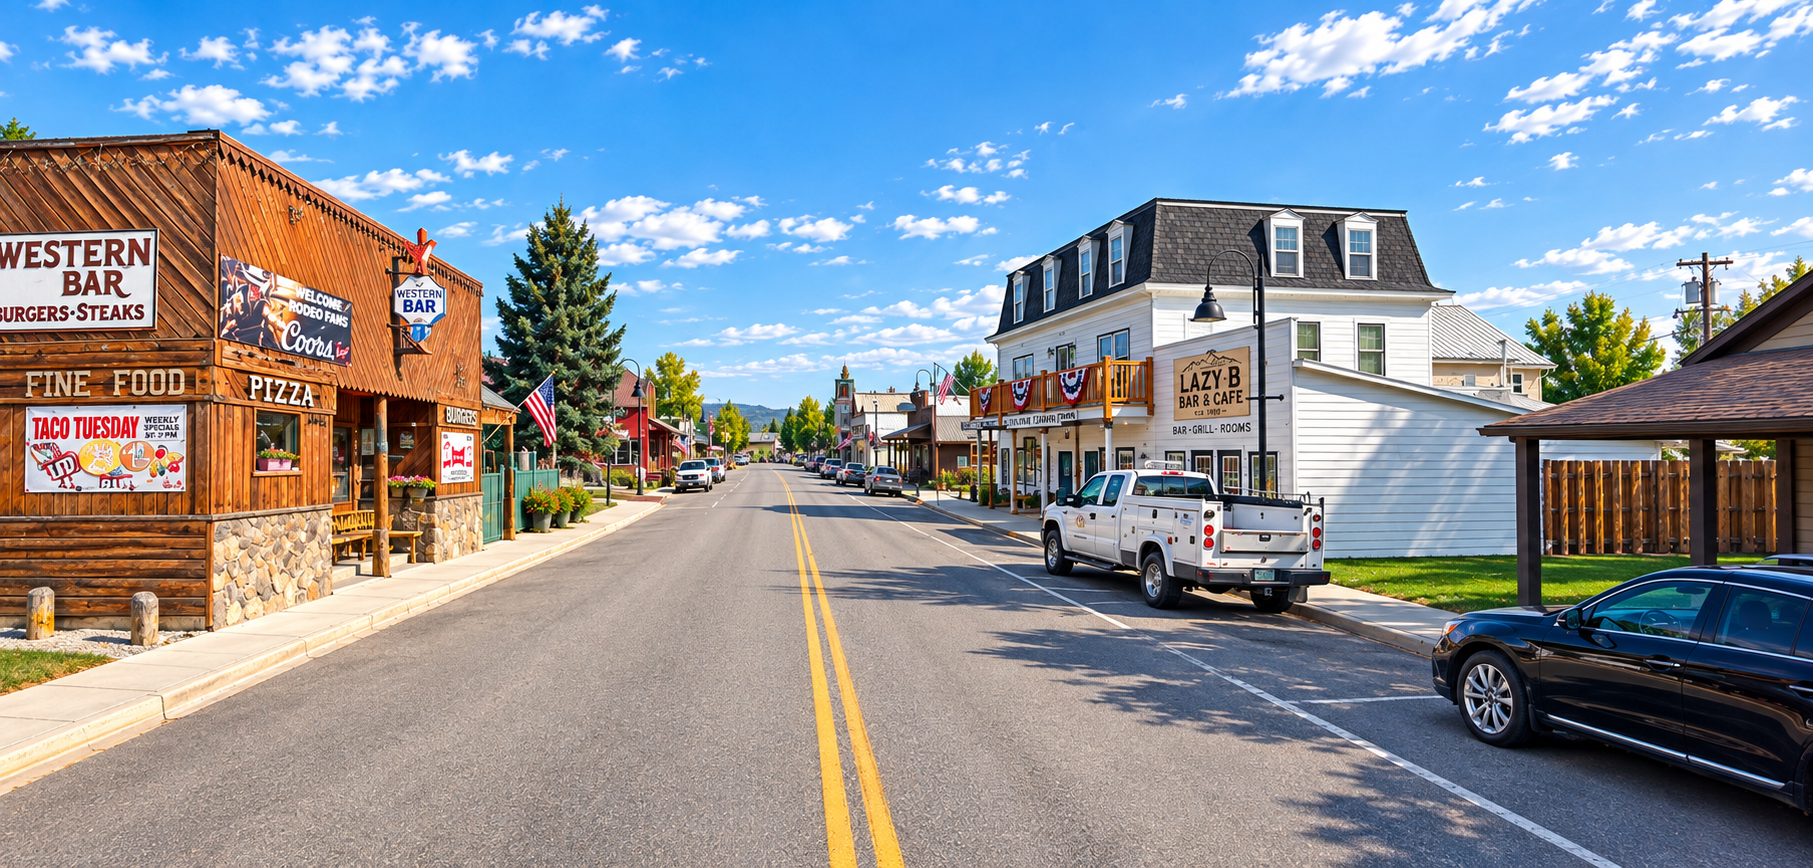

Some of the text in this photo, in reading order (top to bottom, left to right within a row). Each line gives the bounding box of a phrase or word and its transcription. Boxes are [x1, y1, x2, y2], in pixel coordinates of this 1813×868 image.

[0, 238, 151, 269] WESTERN
[61, 270, 132, 298] BAR
[295, 286, 343, 312] WELCOME
[402, 299, 436, 313] BAR
[0, 305, 69, 323] URGERS
[288, 298, 349, 328] RODEO FANS
[25, 368, 185, 397] FINE FOOD
[248, 375, 315, 407] PIZZA
[1179, 394, 1199, 409] BAR
[1213, 390, 1243, 405] CAFE
[32, 416, 140, 439] TACO TUESDAY
[1172, 426, 1187, 435] BAR
[1220, 422, 1251, 433] ROOMS
